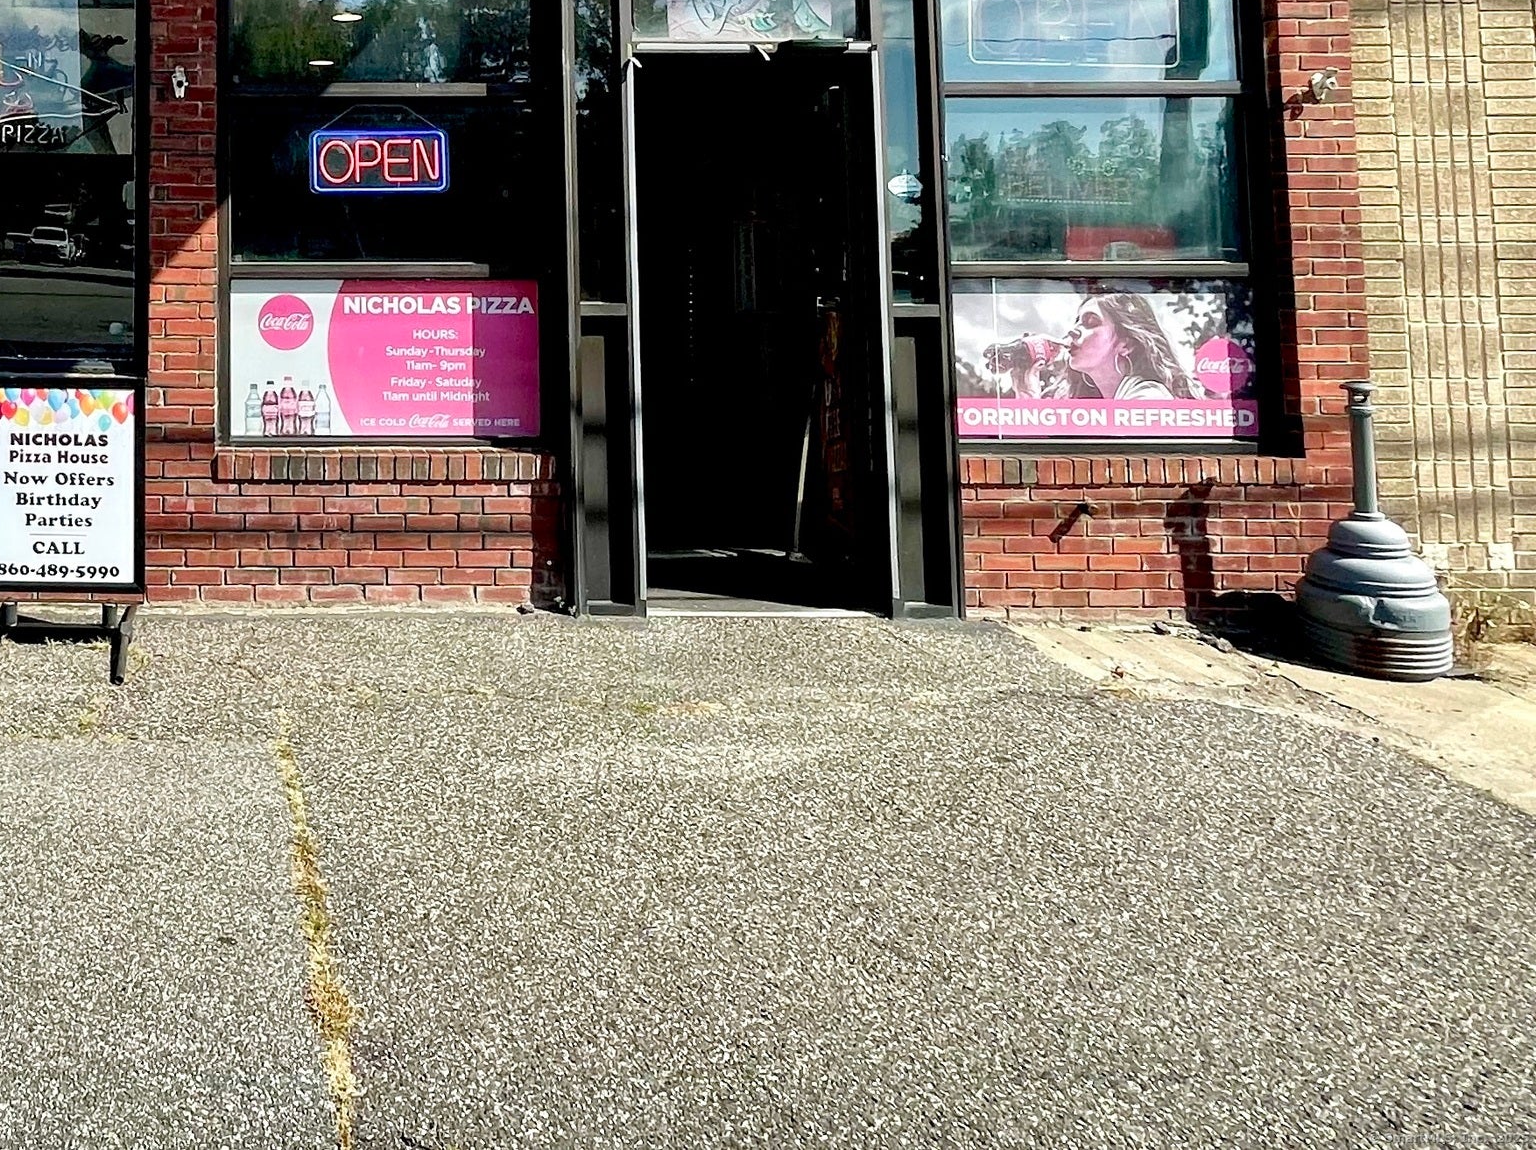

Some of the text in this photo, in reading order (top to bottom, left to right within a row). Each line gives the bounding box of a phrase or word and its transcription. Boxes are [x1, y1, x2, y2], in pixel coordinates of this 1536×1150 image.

[0, 123, 65, 144] PIZZA
[318, 138, 440, 184] OPEN
[342, 295, 536, 316] NICHOLAS PIZZA
[412, 329, 459, 340] HOURS:
[439, 360, 467, 372] 9pm
[390, 376, 426, 389] Friday
[382, 391, 491, 403] 11am until Midnight
[359, 417, 377, 427] ICE
[378, 417, 406, 427] COLD
[452, 418, 492, 427] SERVED
[493, 418, 521, 427] HERE
[1114, 408, 1255, 427] REFRESHED
[9, 432, 109, 447] NICHOLAS
[9, 449, 109, 464] Pizza House
[3, 471, 115, 487] Now Offers
[15, 492, 103, 510] Birthday
[24, 513, 93, 528] Parties
[31, 541, 86, 555] CALL
